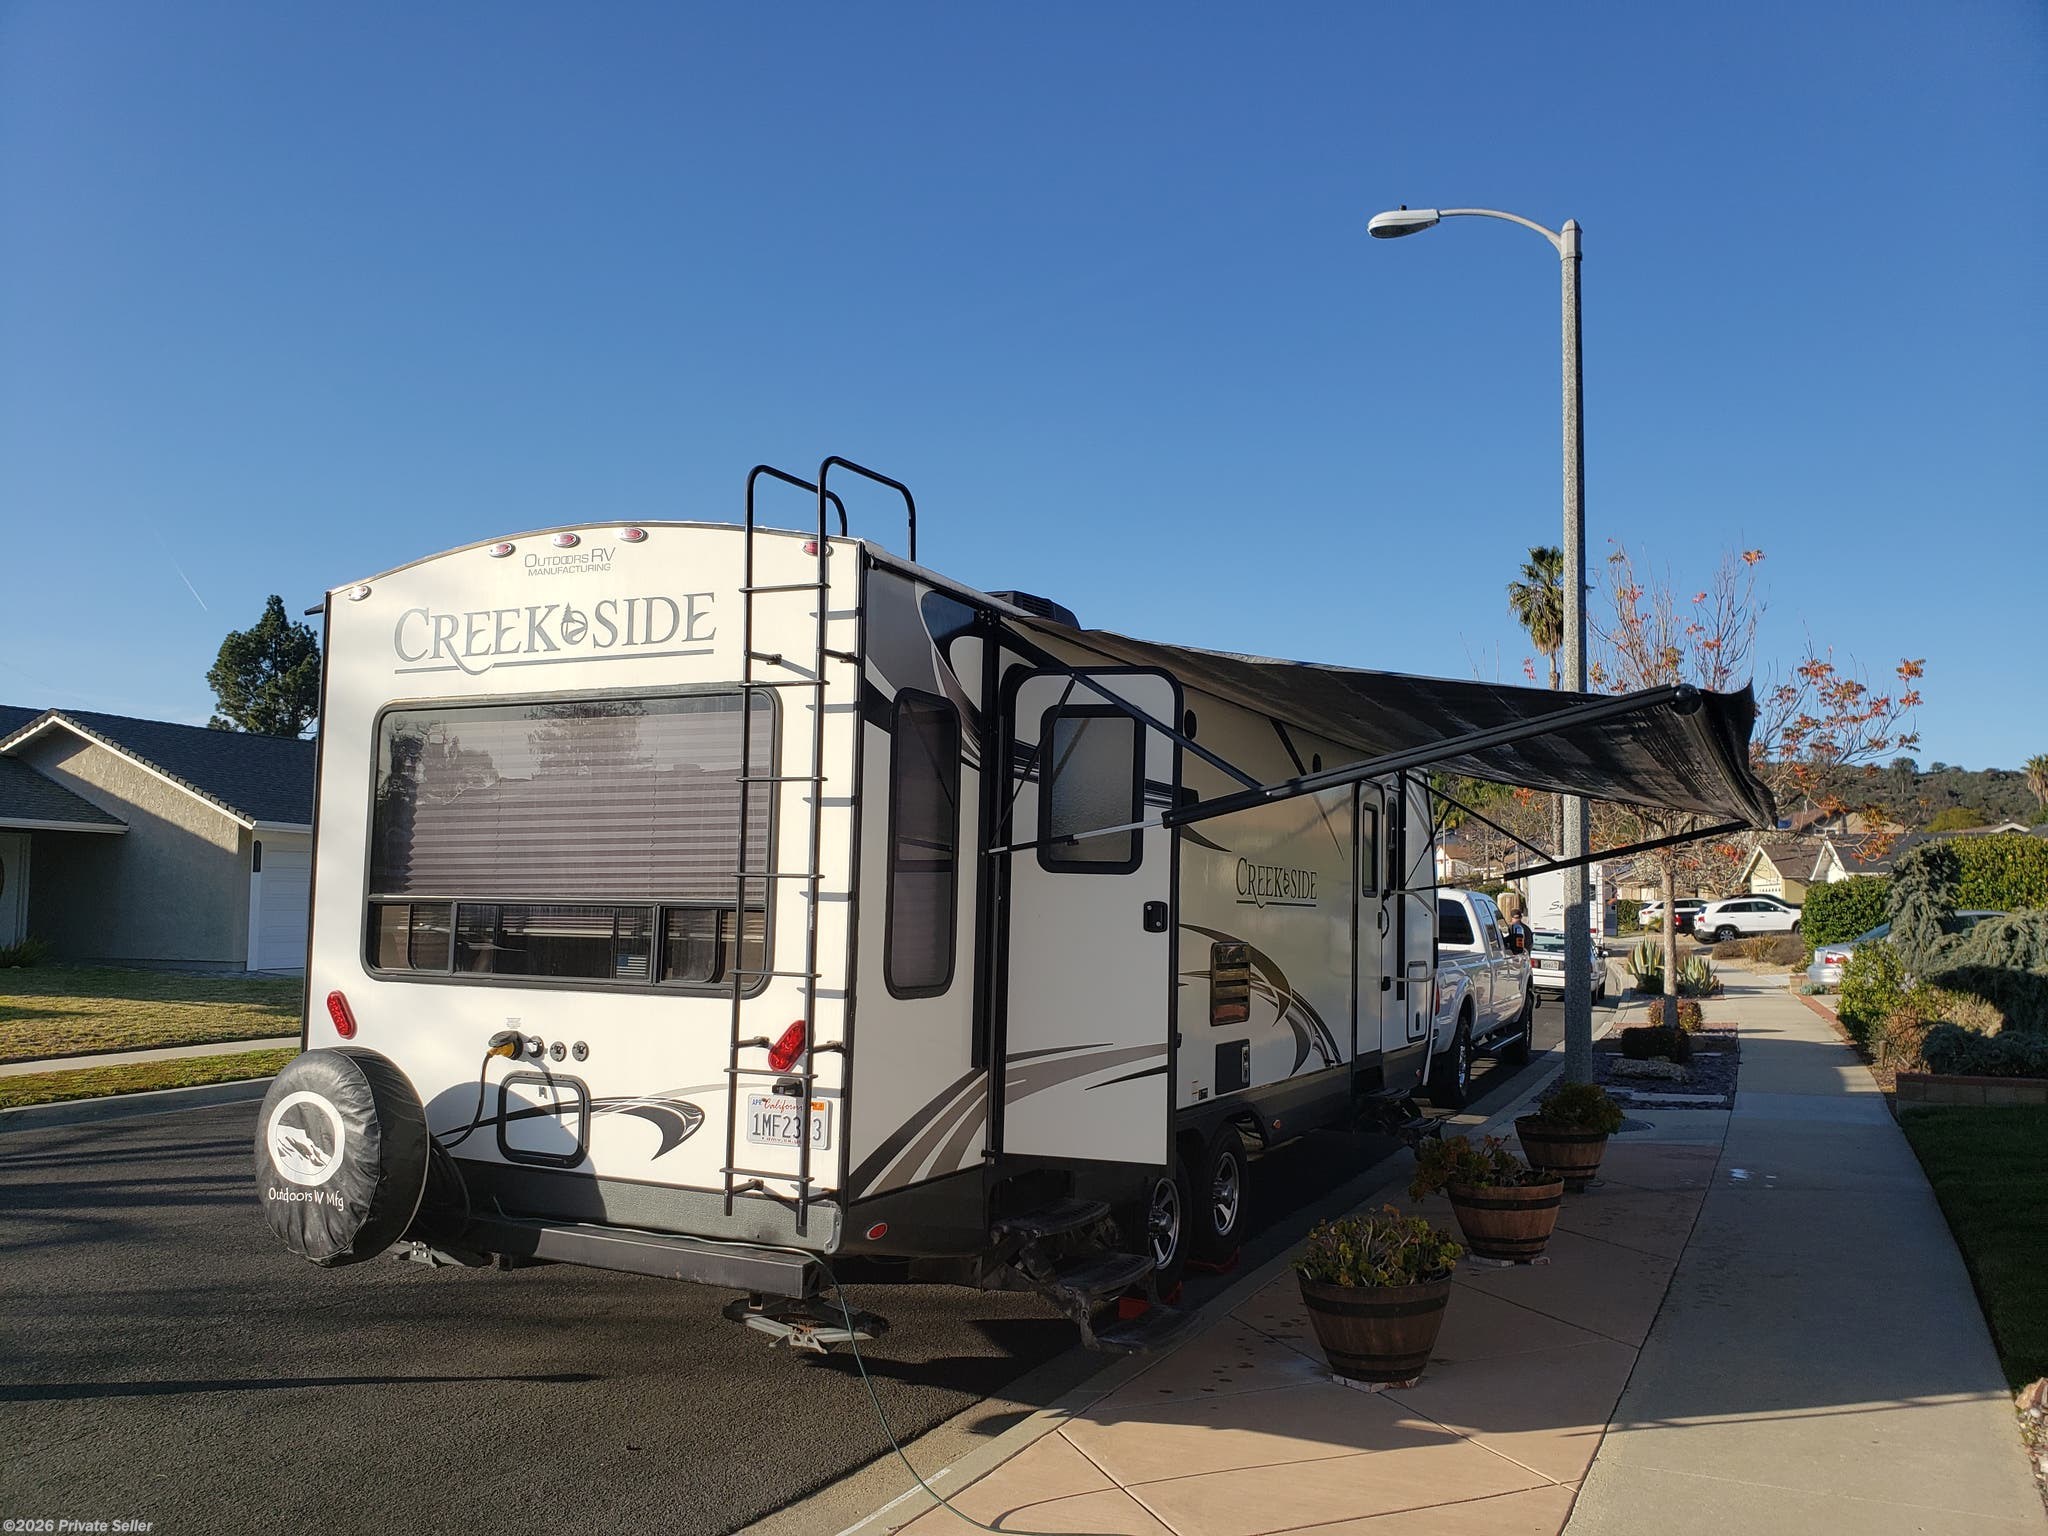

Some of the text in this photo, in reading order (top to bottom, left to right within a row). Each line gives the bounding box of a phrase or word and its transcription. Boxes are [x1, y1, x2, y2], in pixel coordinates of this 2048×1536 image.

[524, 547, 616, 568] OUTDOORS RV
[528, 562, 611, 577] MANUFACTURING
[763, 1097, 803, 1113] Californ
[752, 1112, 822, 1141] 1MF233
[268, 1187, 313, 1204] Outdoors
[326, 1190, 344, 1212] Mfg
